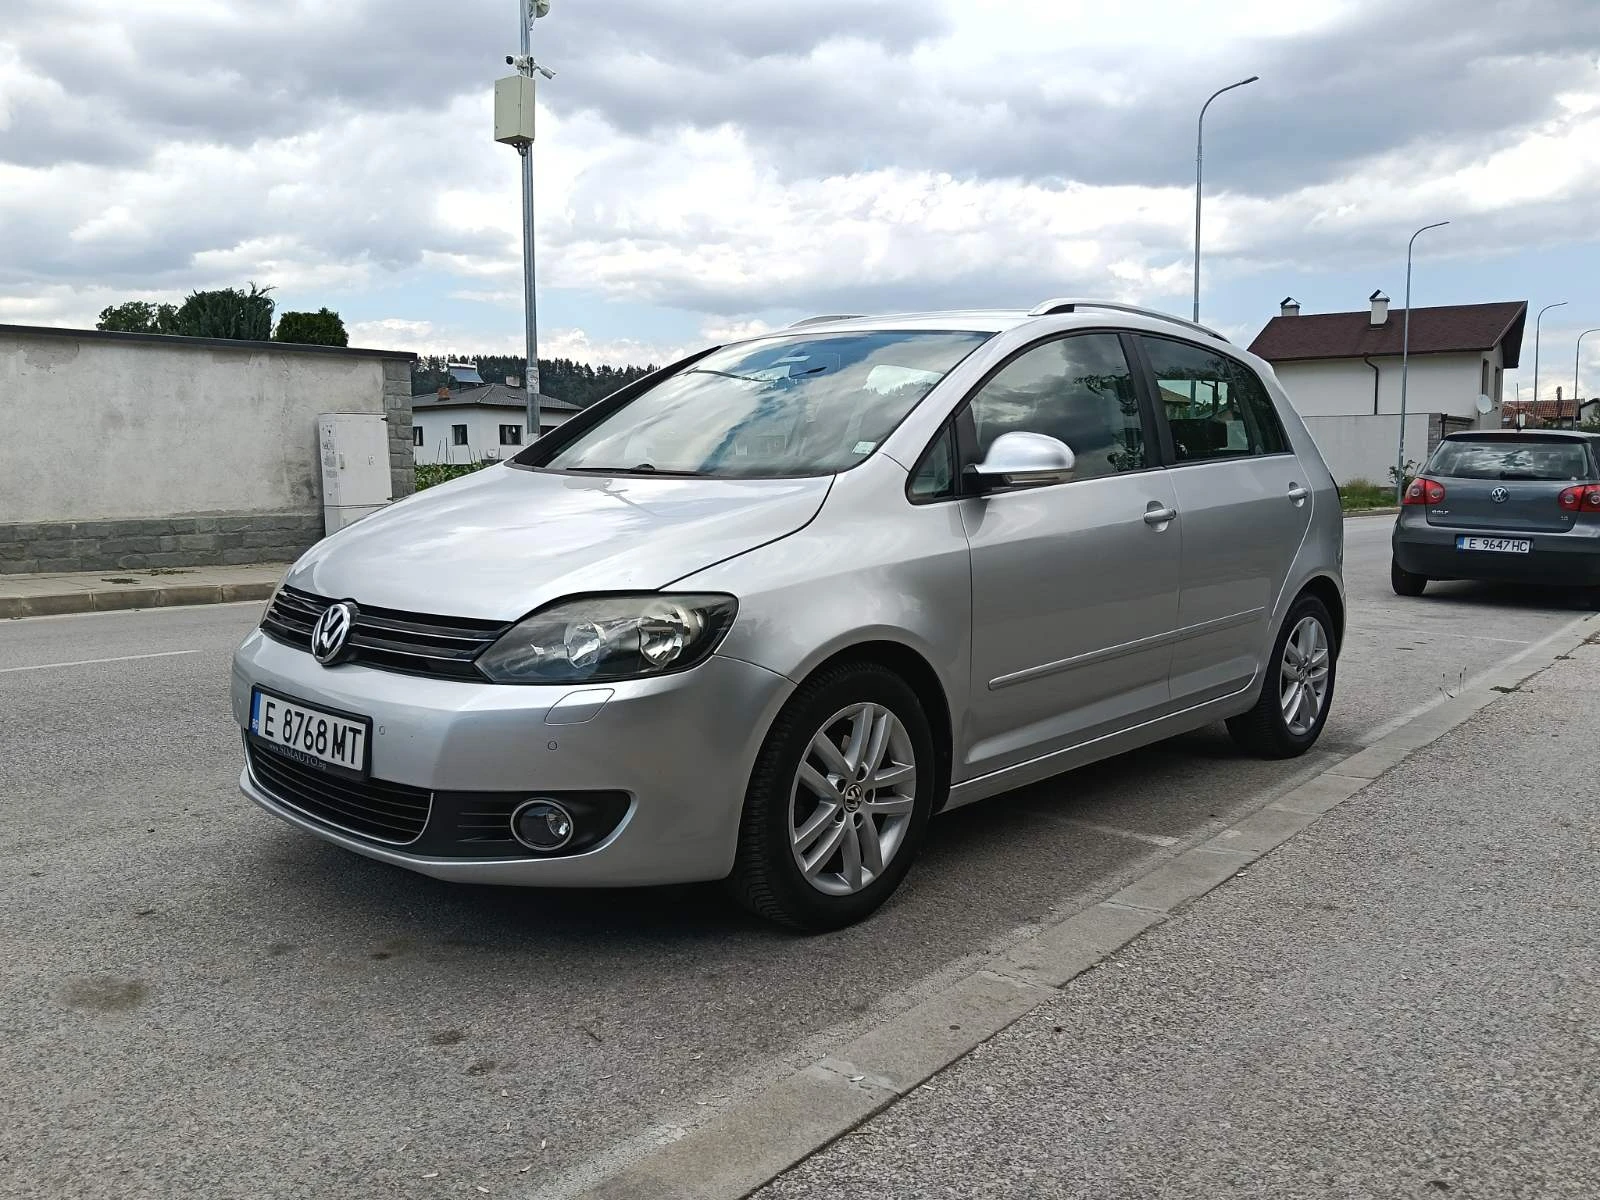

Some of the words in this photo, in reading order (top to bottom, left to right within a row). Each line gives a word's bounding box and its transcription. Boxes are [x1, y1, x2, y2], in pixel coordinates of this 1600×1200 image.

[1469, 539, 1477, 549] E
[1482, 540, 1510, 551] 9647
[1511, 541, 1530, 552] HC
[265, 701, 276, 737] E
[282, 708, 328, 755] 8768
[331, 722, 362, 765] MT
